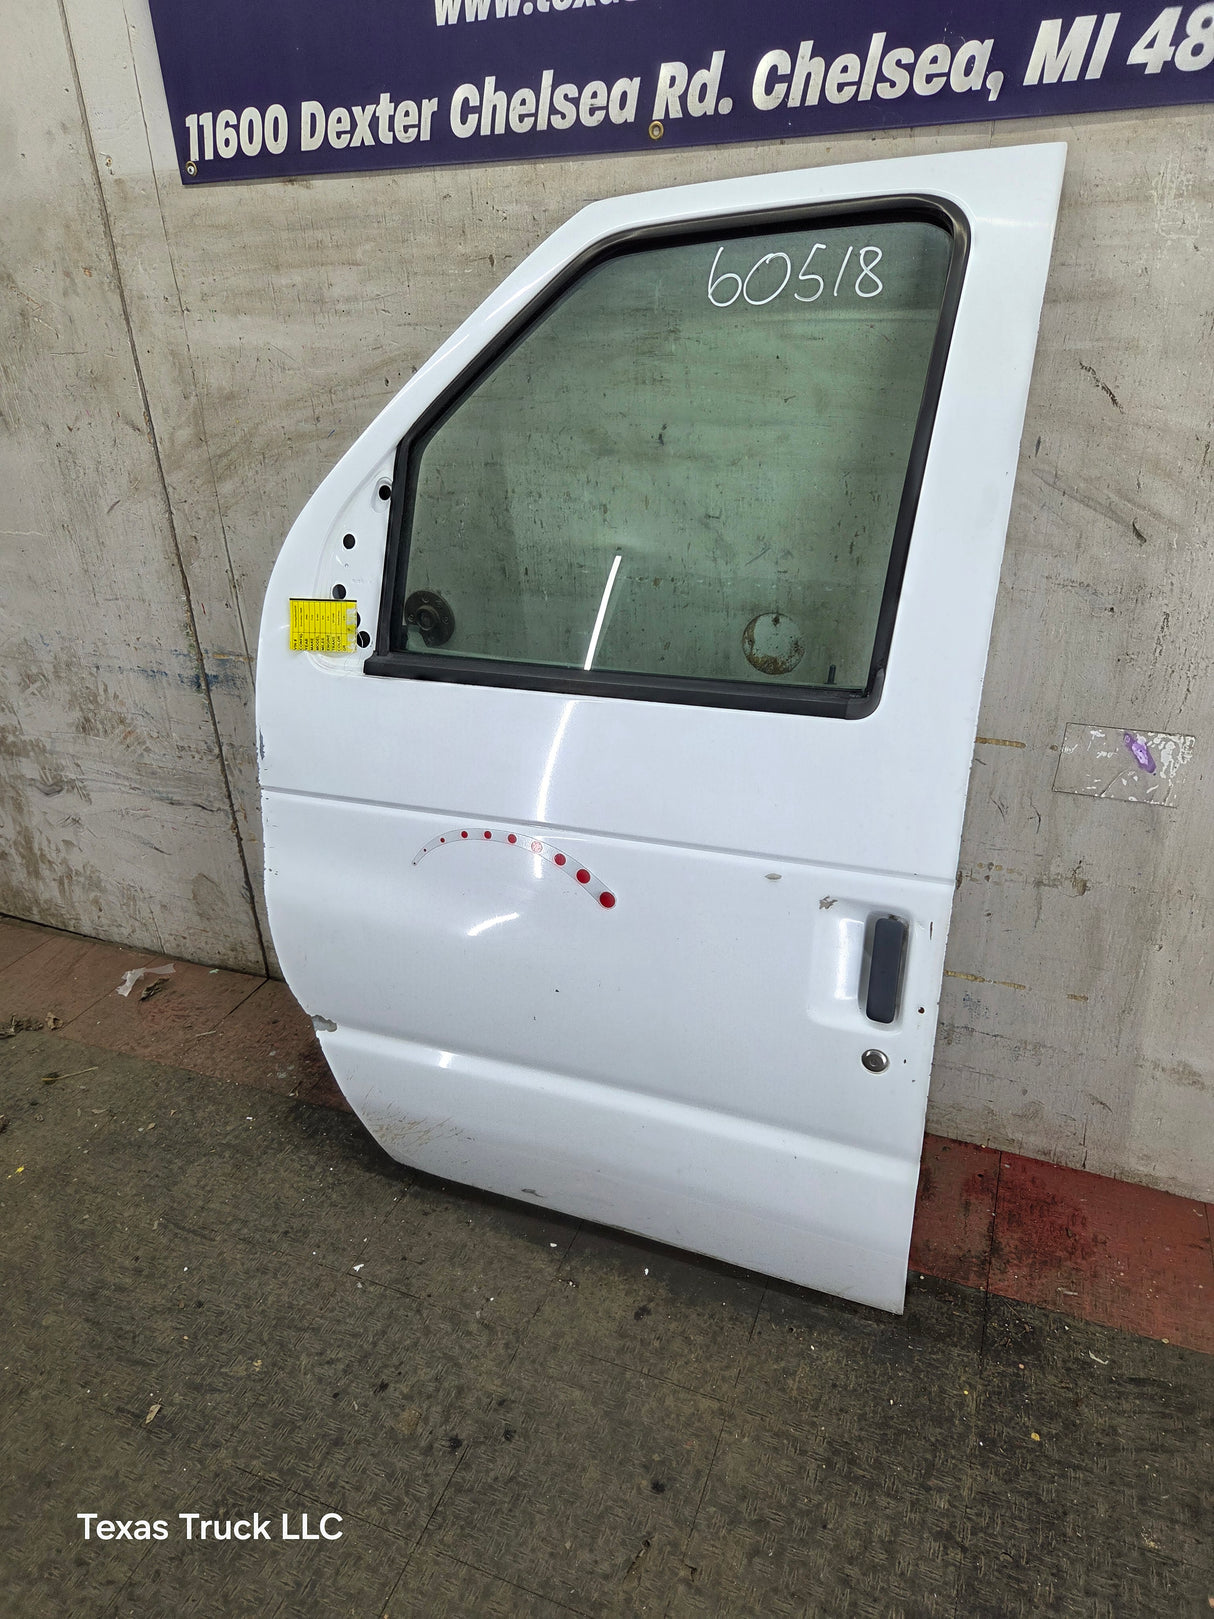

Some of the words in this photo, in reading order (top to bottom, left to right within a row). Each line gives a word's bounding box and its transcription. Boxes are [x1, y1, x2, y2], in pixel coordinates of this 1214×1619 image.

[185, 103, 288, 161] 11600
[300, 93, 438, 151] Dexter
[450, 69, 641, 138] Chelsea
[652, 50, 733, 120] Rd.
[751, 32, 1004, 101] Chelsea,
[1022, 12, 1121, 86] MI
[1126, 2, 1214, 74] 48
[707, 243, 884, 308] 60518
